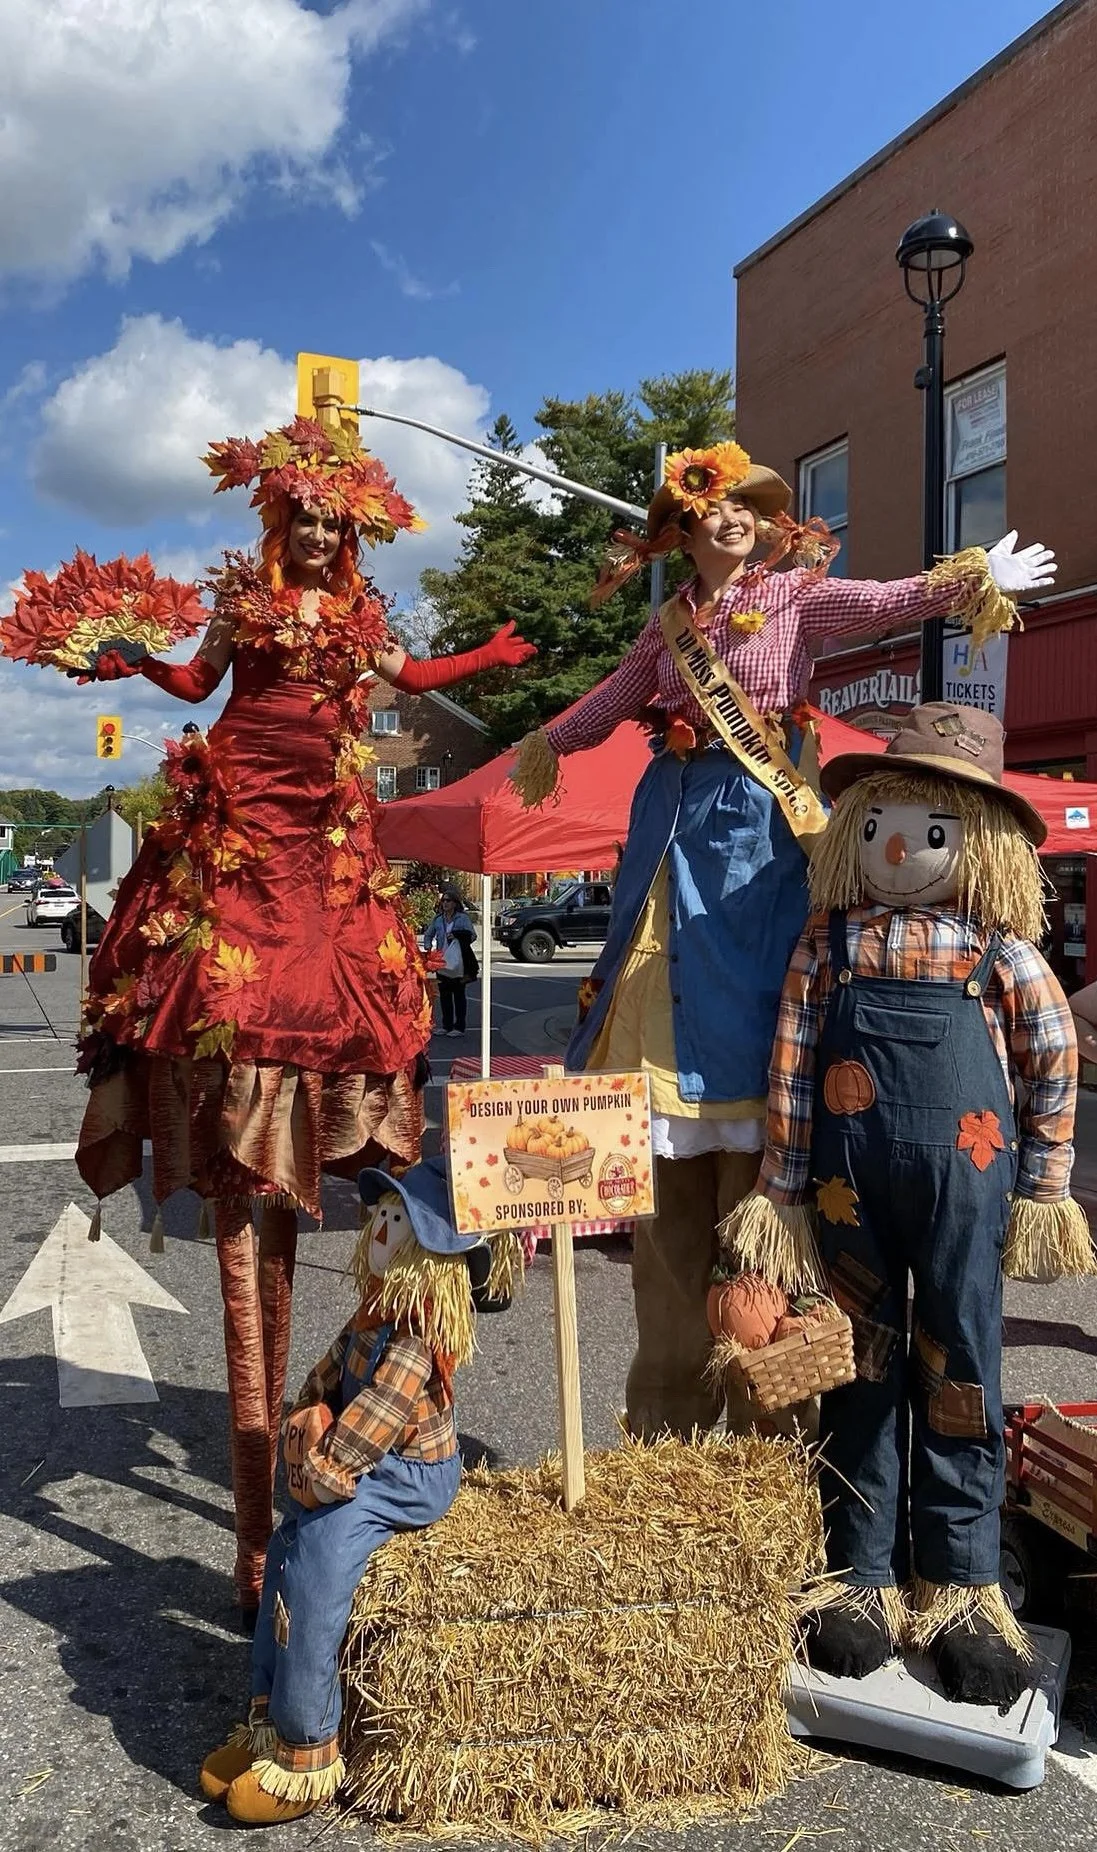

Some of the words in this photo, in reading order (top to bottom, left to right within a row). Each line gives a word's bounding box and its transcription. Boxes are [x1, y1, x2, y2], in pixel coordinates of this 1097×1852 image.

[957, 395, 972, 410] FOR
[973, 384, 997, 404] LEASE
[946, 682, 996, 700] TICKETS
[684, 648, 716, 687] Miss
[708, 681, 773, 768] Pumpkin
[769, 768, 809, 817] Spice
[470, 1101, 513, 1118] DESIGN
[516, 1098, 548, 1116] YOUR
[552, 1097, 580, 1113] OWN
[583, 1093, 631, 1111] PUMPKIN
[495, 1200, 565, 1221] SPONSORED
[569, 1199, 588, 1215] BY:
